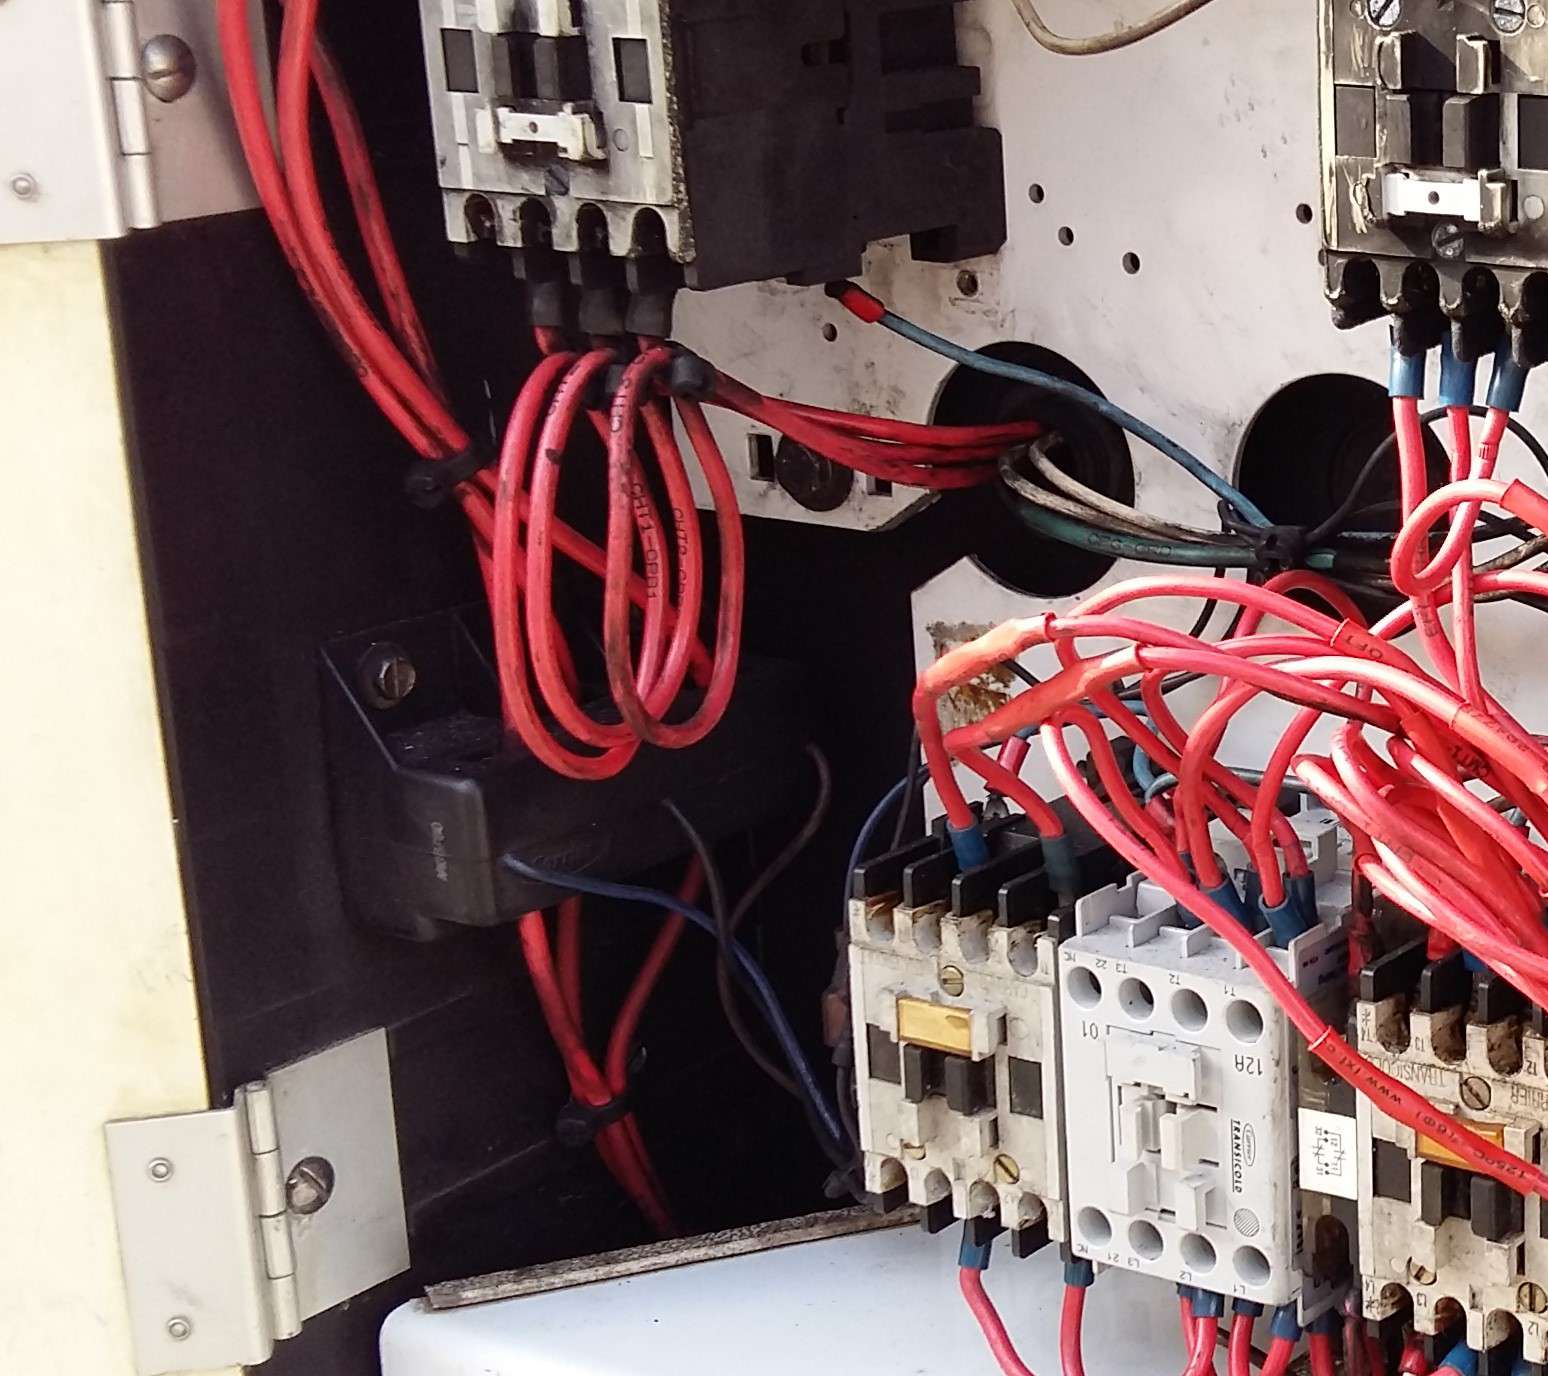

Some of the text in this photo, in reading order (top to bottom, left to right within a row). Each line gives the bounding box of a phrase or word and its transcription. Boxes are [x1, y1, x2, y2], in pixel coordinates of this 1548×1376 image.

[1115, 962, 1128, 974] T3
[1169, 972, 1181, 985] T2
[1223, 984, 1237, 997] T1
[1234, 1053, 1263, 1076] 12A
[1232, 1119, 1243, 1194] TRANSICOLD
[1179, 1270, 1193, 1282] L2
[1233, 1284, 1246, 1295] L1
